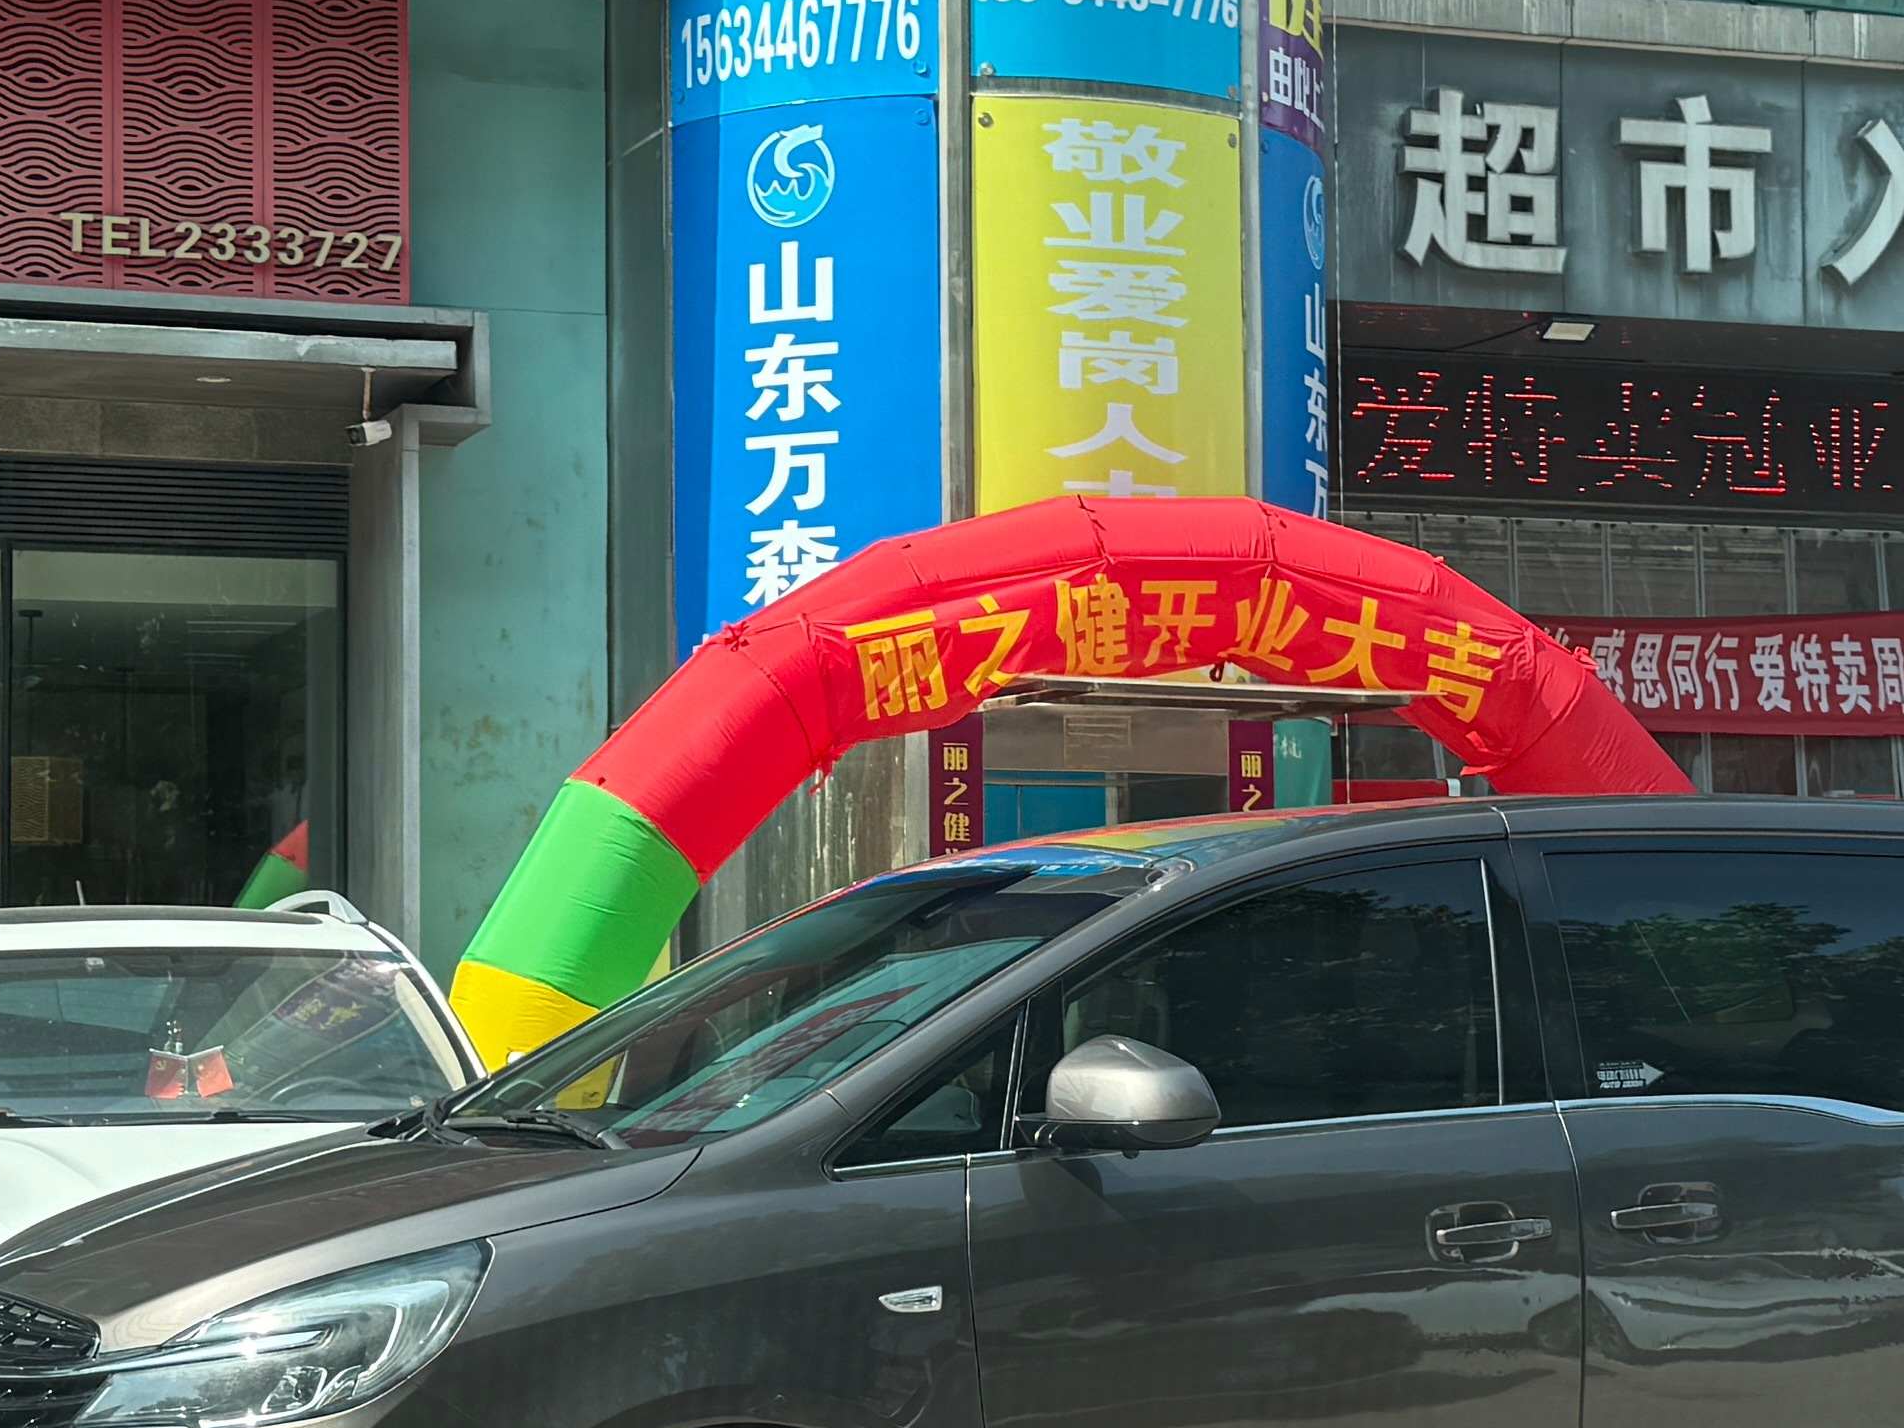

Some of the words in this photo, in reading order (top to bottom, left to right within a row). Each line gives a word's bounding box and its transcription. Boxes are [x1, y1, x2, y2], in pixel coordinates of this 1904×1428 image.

[844, 573, 1503, 723] 丽之健开业大吉
[943, 743, 971, 857] 丽之健
